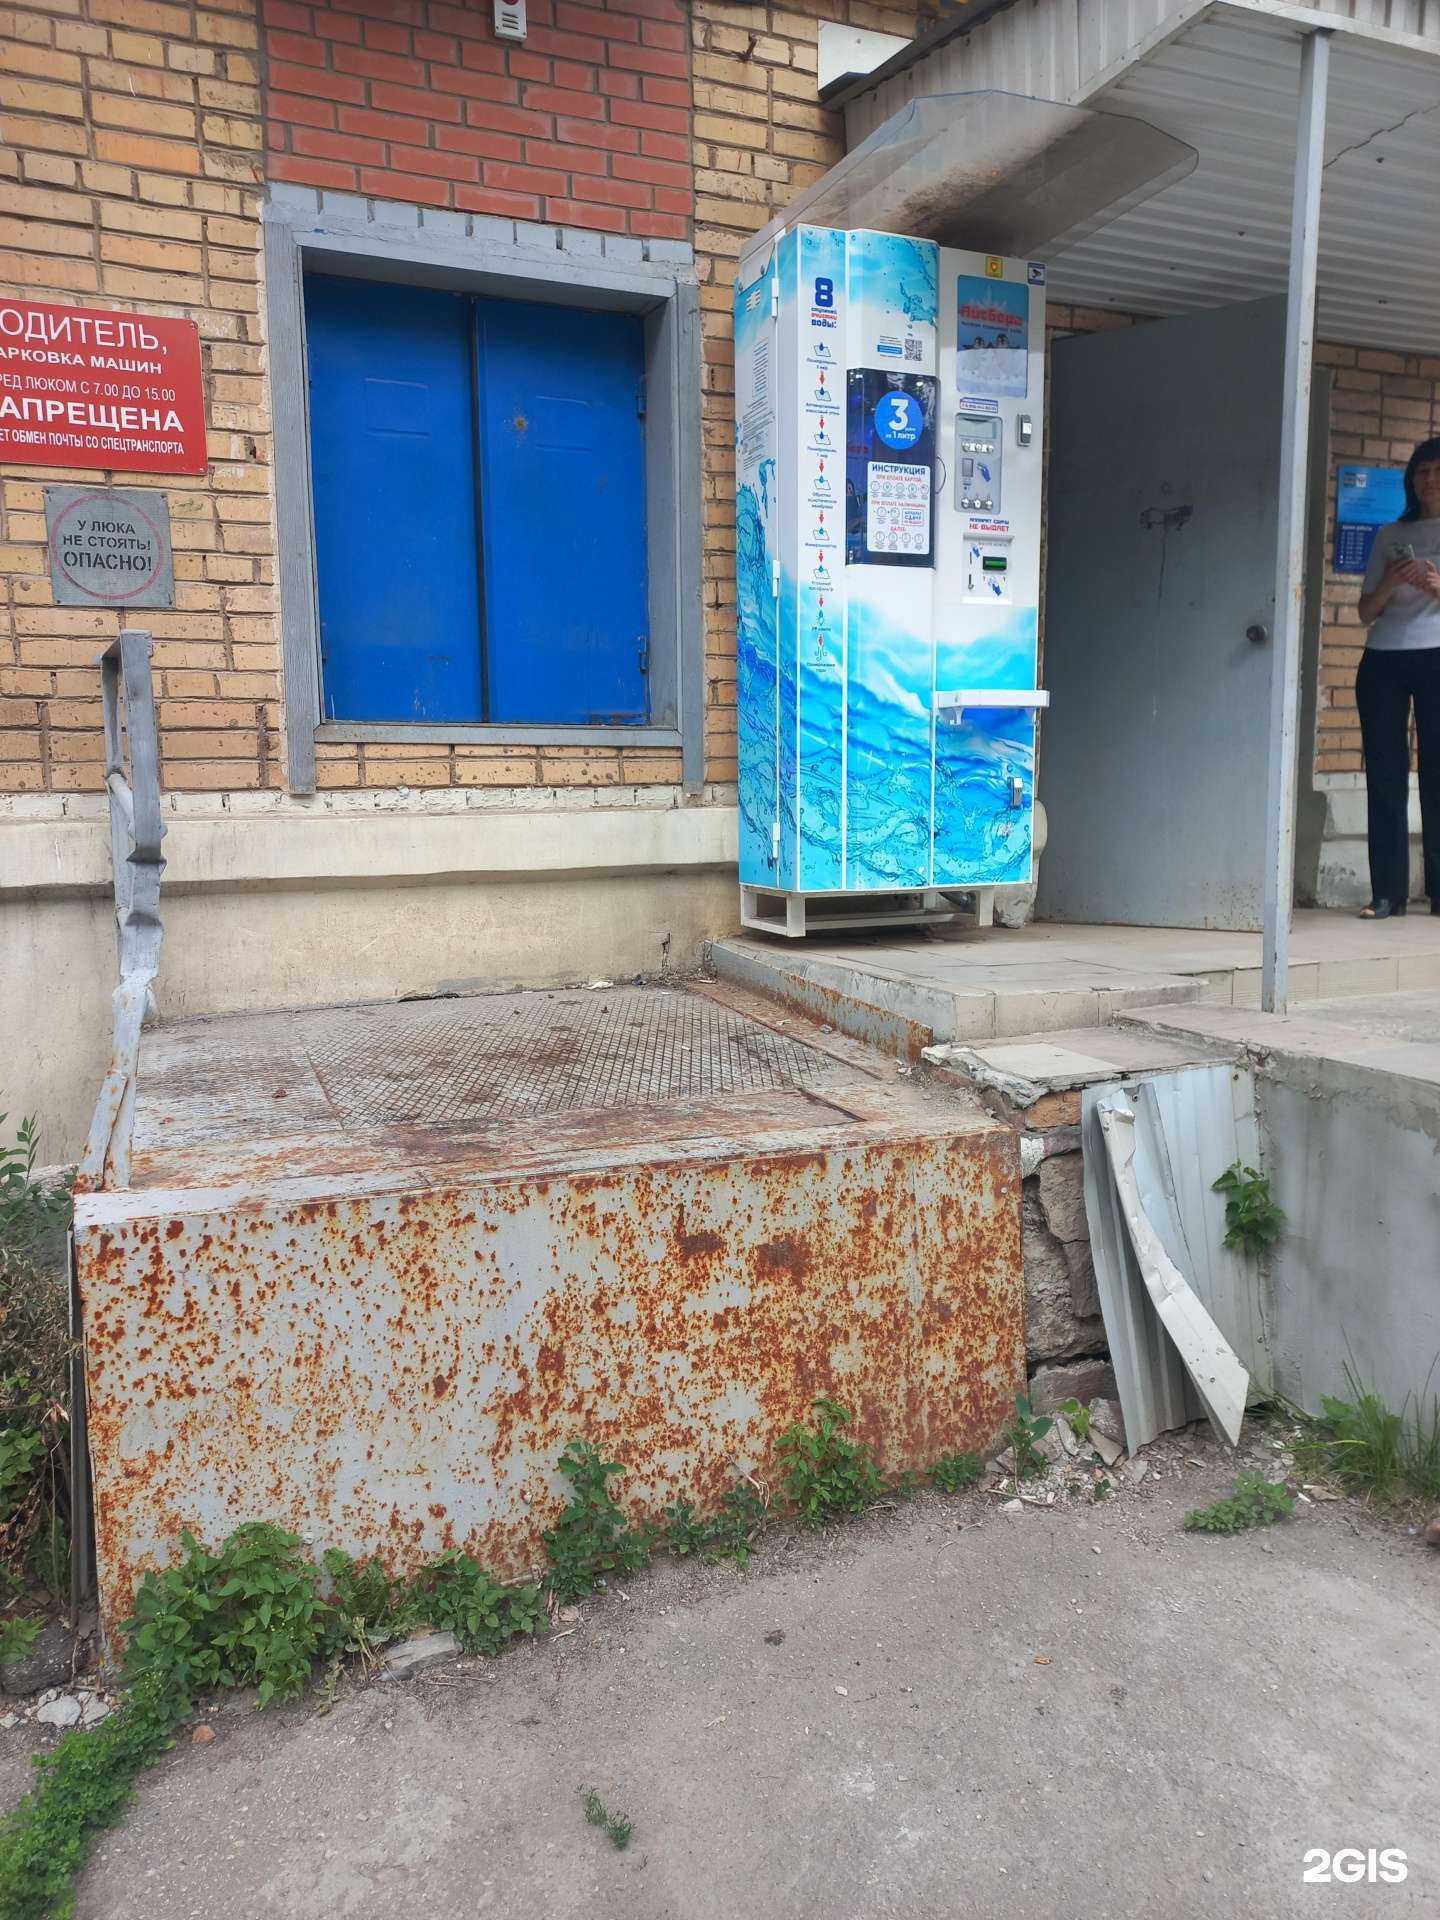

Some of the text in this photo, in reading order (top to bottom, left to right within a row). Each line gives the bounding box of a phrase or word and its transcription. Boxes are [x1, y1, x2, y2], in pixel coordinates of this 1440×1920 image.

[815, 277, 833, 307] 8
[90, 355, 162, 374] МАШИН
[25, 375, 77, 393] ЛЮКОМ
[80, 381, 90, 394] С
[93, 382, 119, 397] 7.00
[122, 385, 141, 400] ДО
[144, 387, 176, 402] 15.00
[0, 395, 185, 433] АПРЕЩЕНА
[888, 398, 909, 431] 3
[12, 429, 47, 445] ОБМЕН
[48, 432, 84, 448] ПОЧТЫ
[85, 436, 99, 449] СО
[101, 436, 185, 455] СПЕЦТРАНСПОРТА
[872, 463, 926, 476] ИНСТРУКЦИЯ
[77, 520, 136, 535] У ЛЮКА
[63, 534, 151, 551] НЕ СТОЯТЬ!
[63, 551, 152, 572] ОПАСНО!
